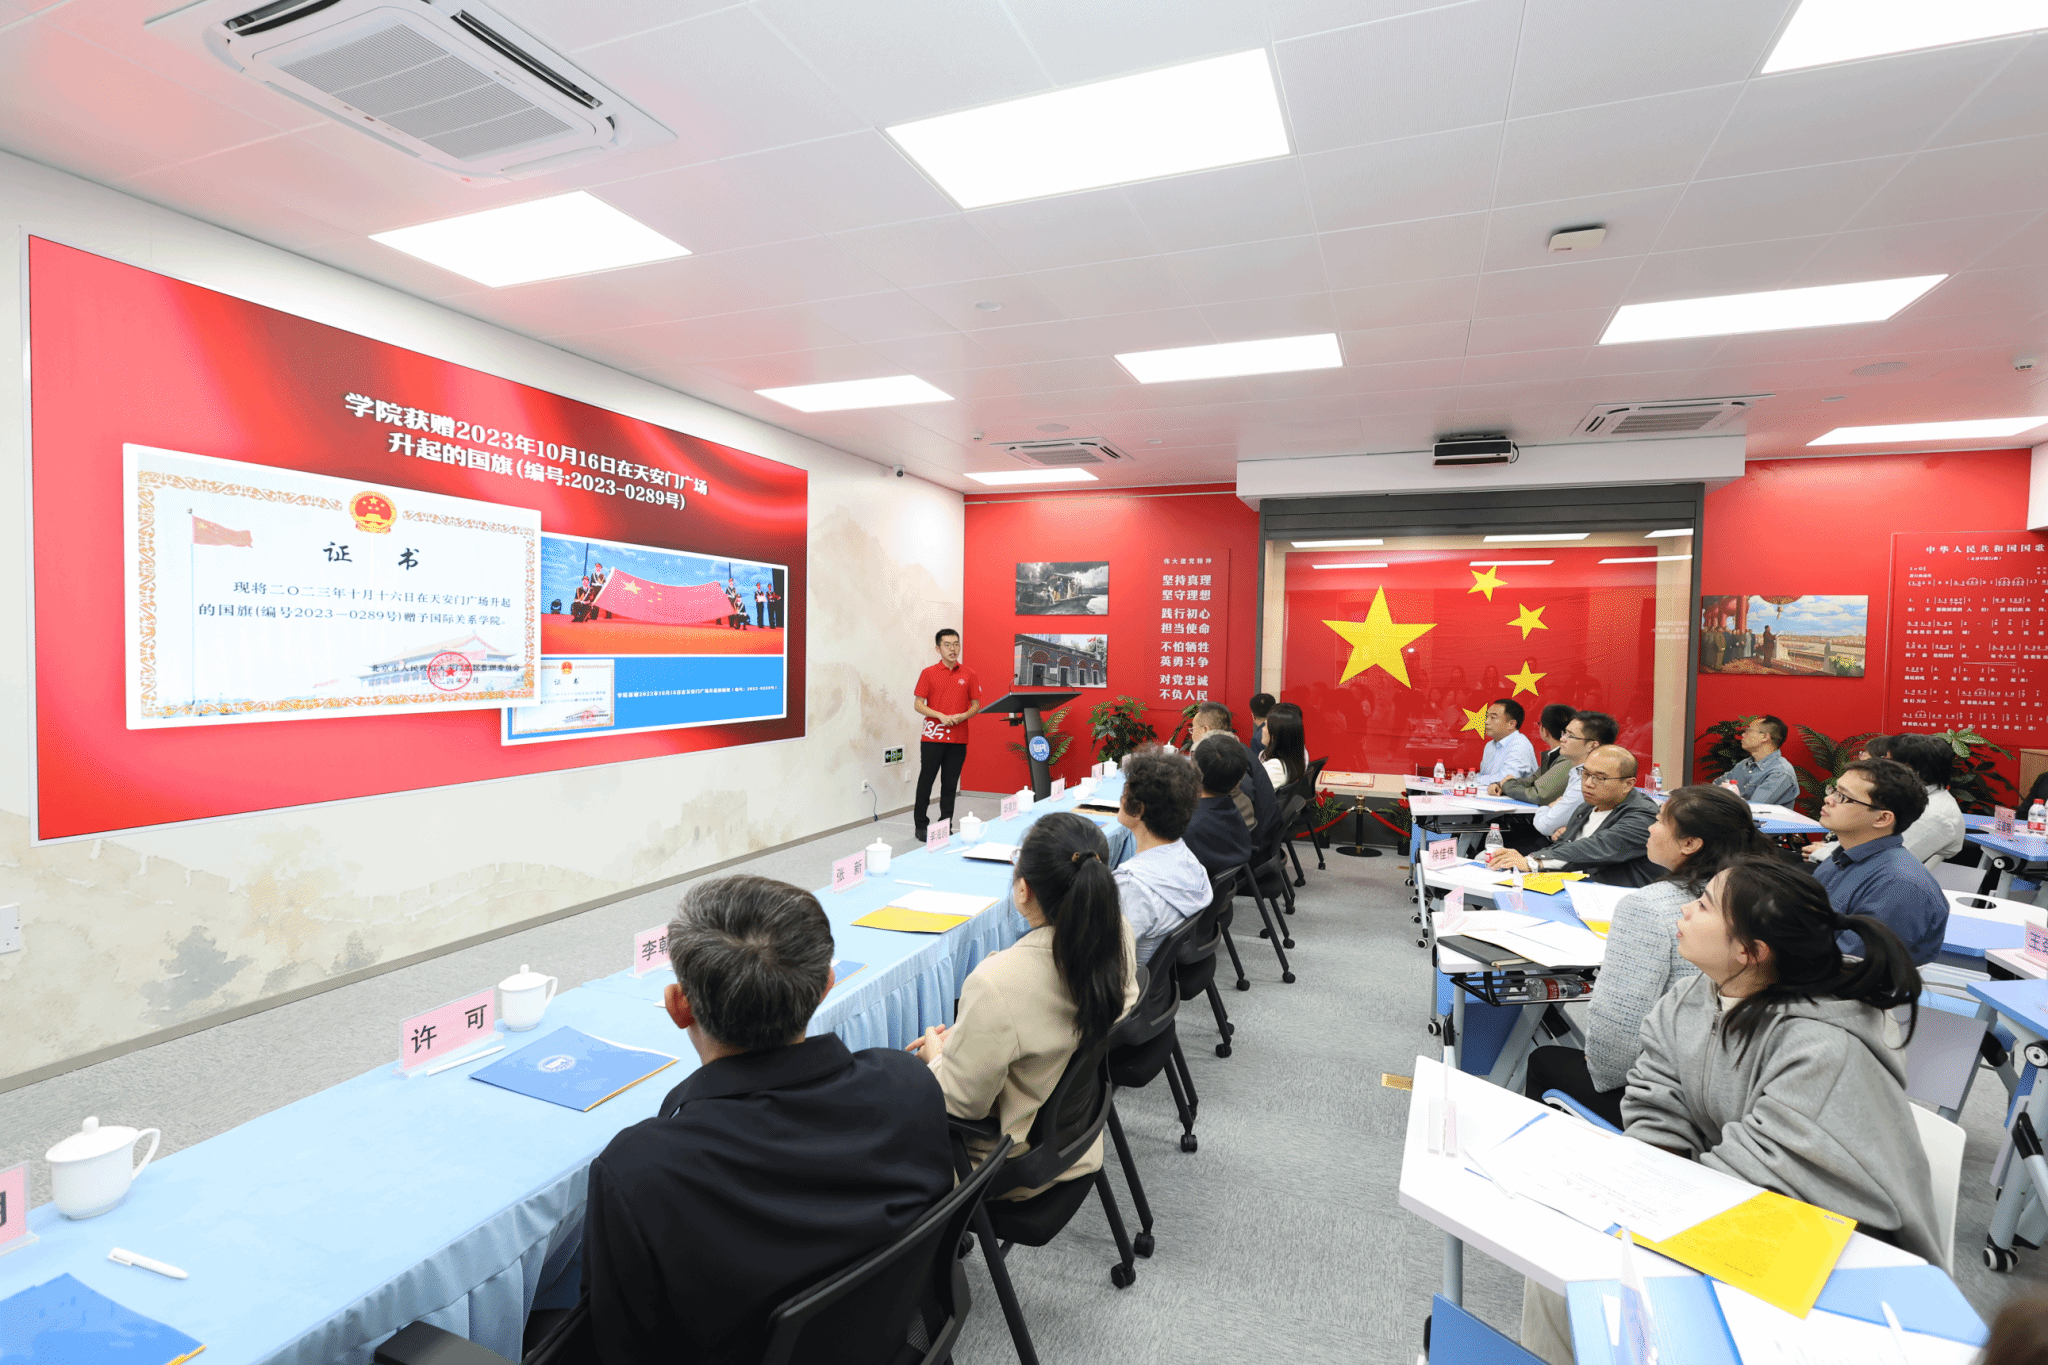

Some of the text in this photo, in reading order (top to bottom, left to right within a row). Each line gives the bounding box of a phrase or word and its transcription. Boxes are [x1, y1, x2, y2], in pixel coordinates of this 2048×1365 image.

[344, 392, 709, 495] 学院获赠2023年10月16日在天安门广场
[1925, 543, 2046, 554] 中华人民共和国国歌
[323, 542, 419, 570] 证书
[1162, 575, 1212, 586] 坚持真理
[1162, 590, 1211, 601] 坚守理想
[1161, 608, 1211, 619] 践行初心
[1161, 623, 1210, 634] 担当使命
[1160, 641, 1210, 653] 不怕牺牲
[1160, 656, 1209, 667] 英勇斗争
[1159, 674, 1209, 686] 对党忠诚
[1159, 689, 1208, 701] 不负人民
[411, 1004, 487, 1053] 许可
